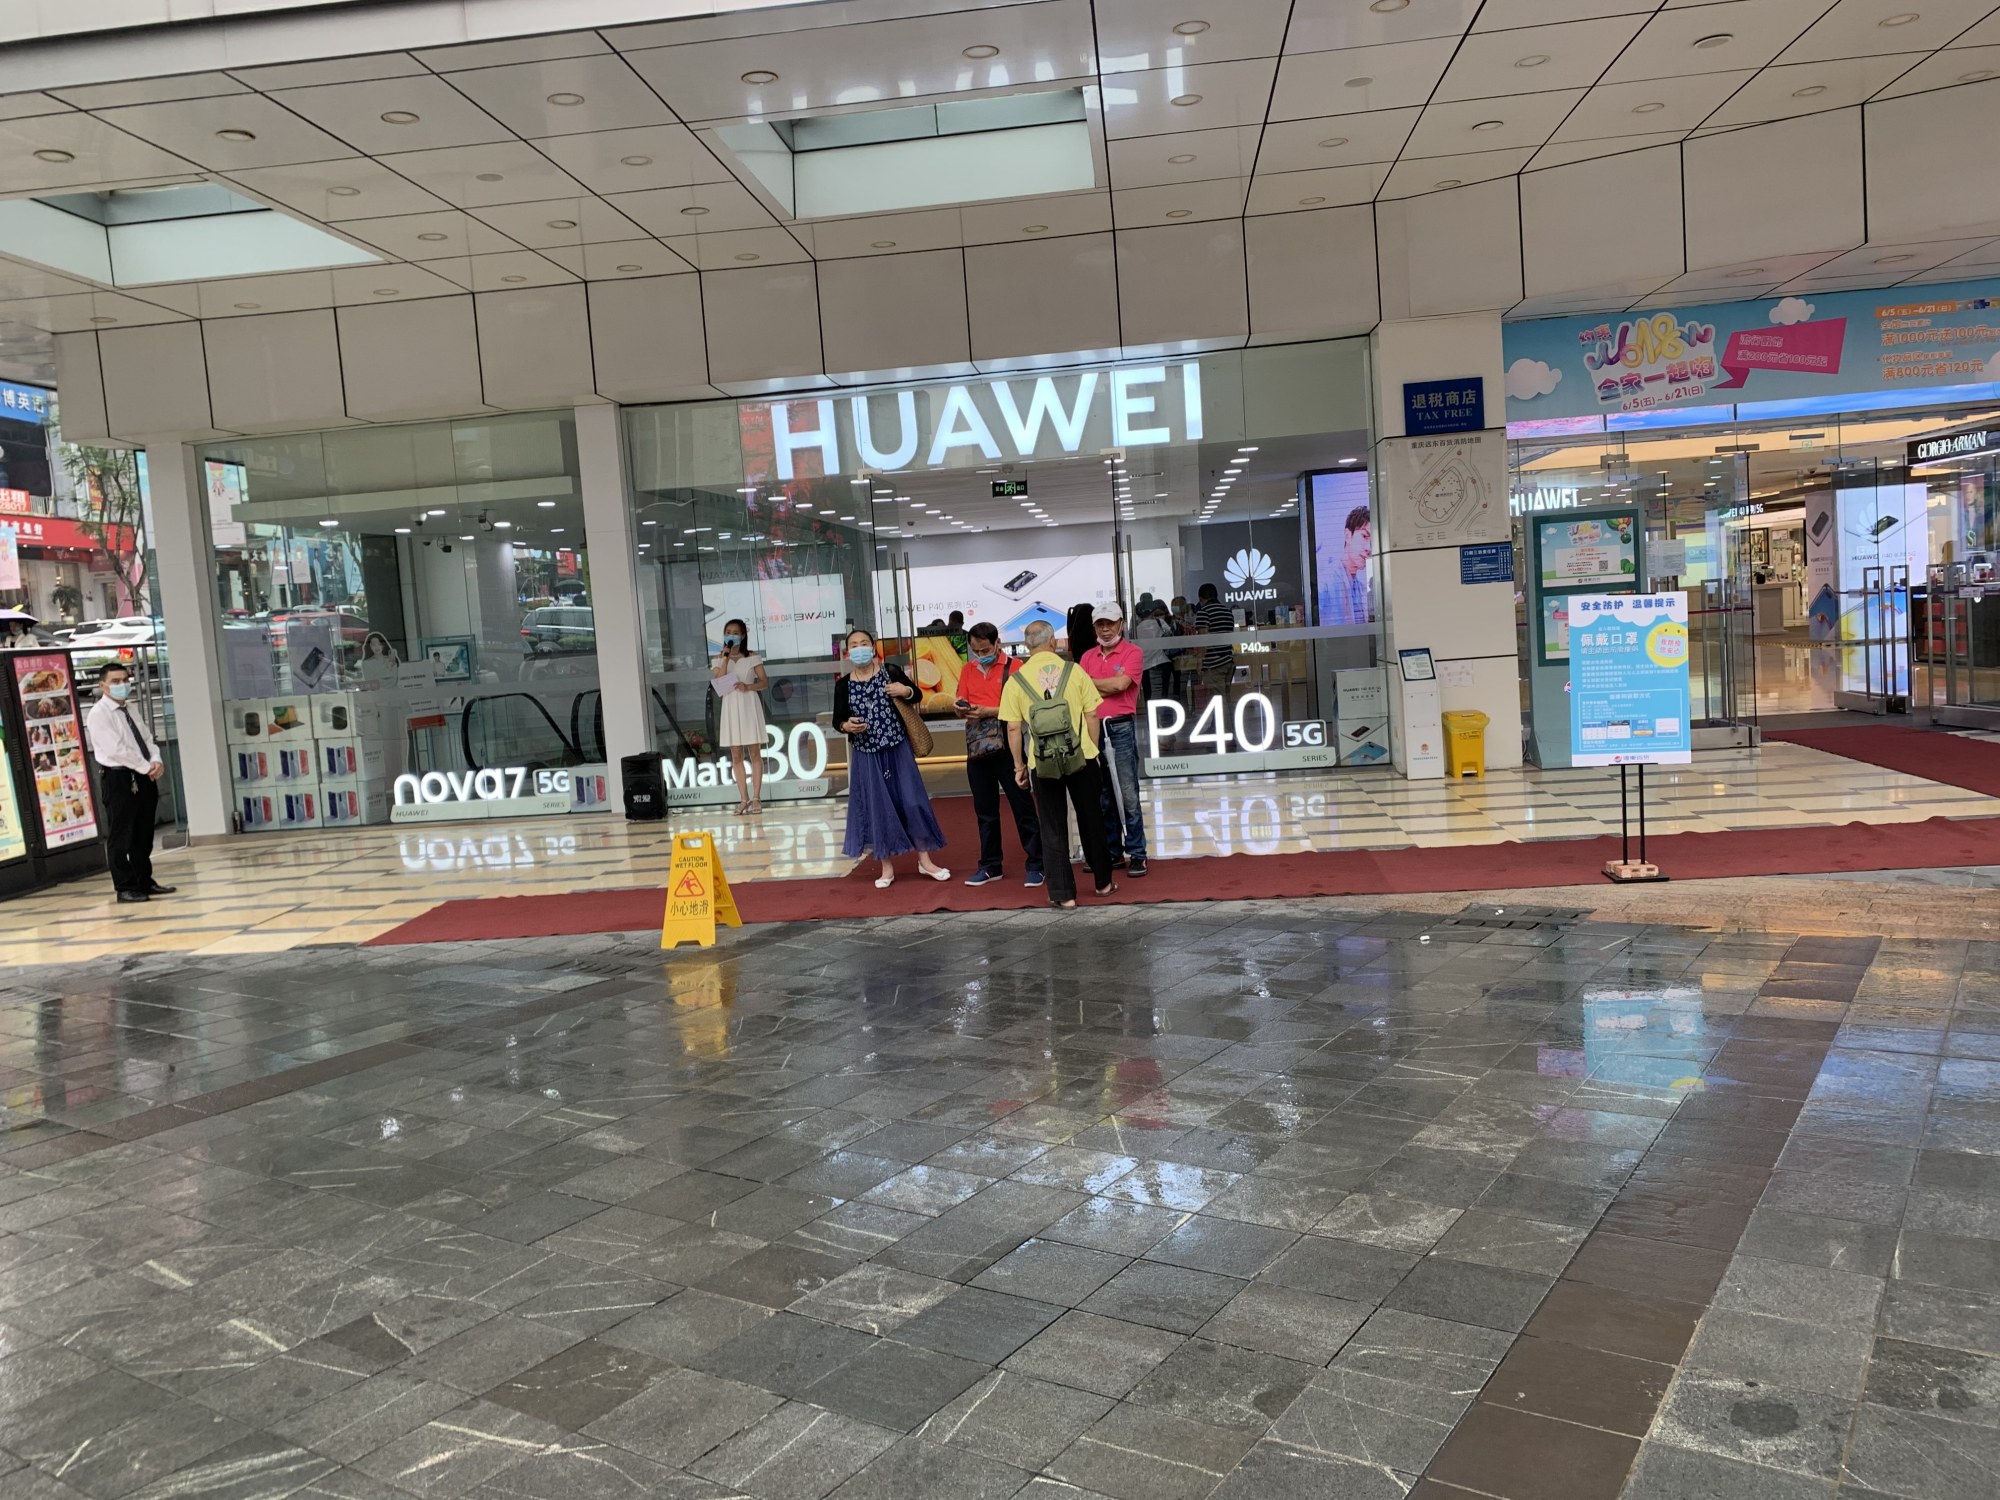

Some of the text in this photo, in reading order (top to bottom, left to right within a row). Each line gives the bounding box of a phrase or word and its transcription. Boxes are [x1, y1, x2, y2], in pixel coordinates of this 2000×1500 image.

[1883, 359, 1985, 380] 满800元省120元
[1597, 356, 1715, 401] 全家一起嗨
[1411, 389, 1478, 409] 退税商店
[771, 362, 1204, 480] HUAWEI
[1417, 407, 1473, 421] TAX FREE
[1917, 431, 1987, 459] GIORGIO ARMANI
[1509, 488, 1580, 517] HUAWEI
[1225, 588, 1277, 602] HUAWEI
[1581, 597, 1676, 611] 安全防护 温馨提示
[1581, 631, 1638, 647] 佩戴口罩
[1240, 641, 1261, 654] P40
[1146, 692, 1324, 759] P40 5G
[661, 721, 828, 790] Mate 30
[1302, 754, 1328, 763] SERIES
[1152, 762, 1190, 772] HUAWEI
[393, 766, 571, 806] nova7 5G
[797, 785, 821, 794] SERIES
[667, 792, 702, 801] HUAWEI
[543, 801, 565, 809] SERIES
[395, 809, 429, 818] HUAWEI
[670, 899, 709, 916] 小心地滑
